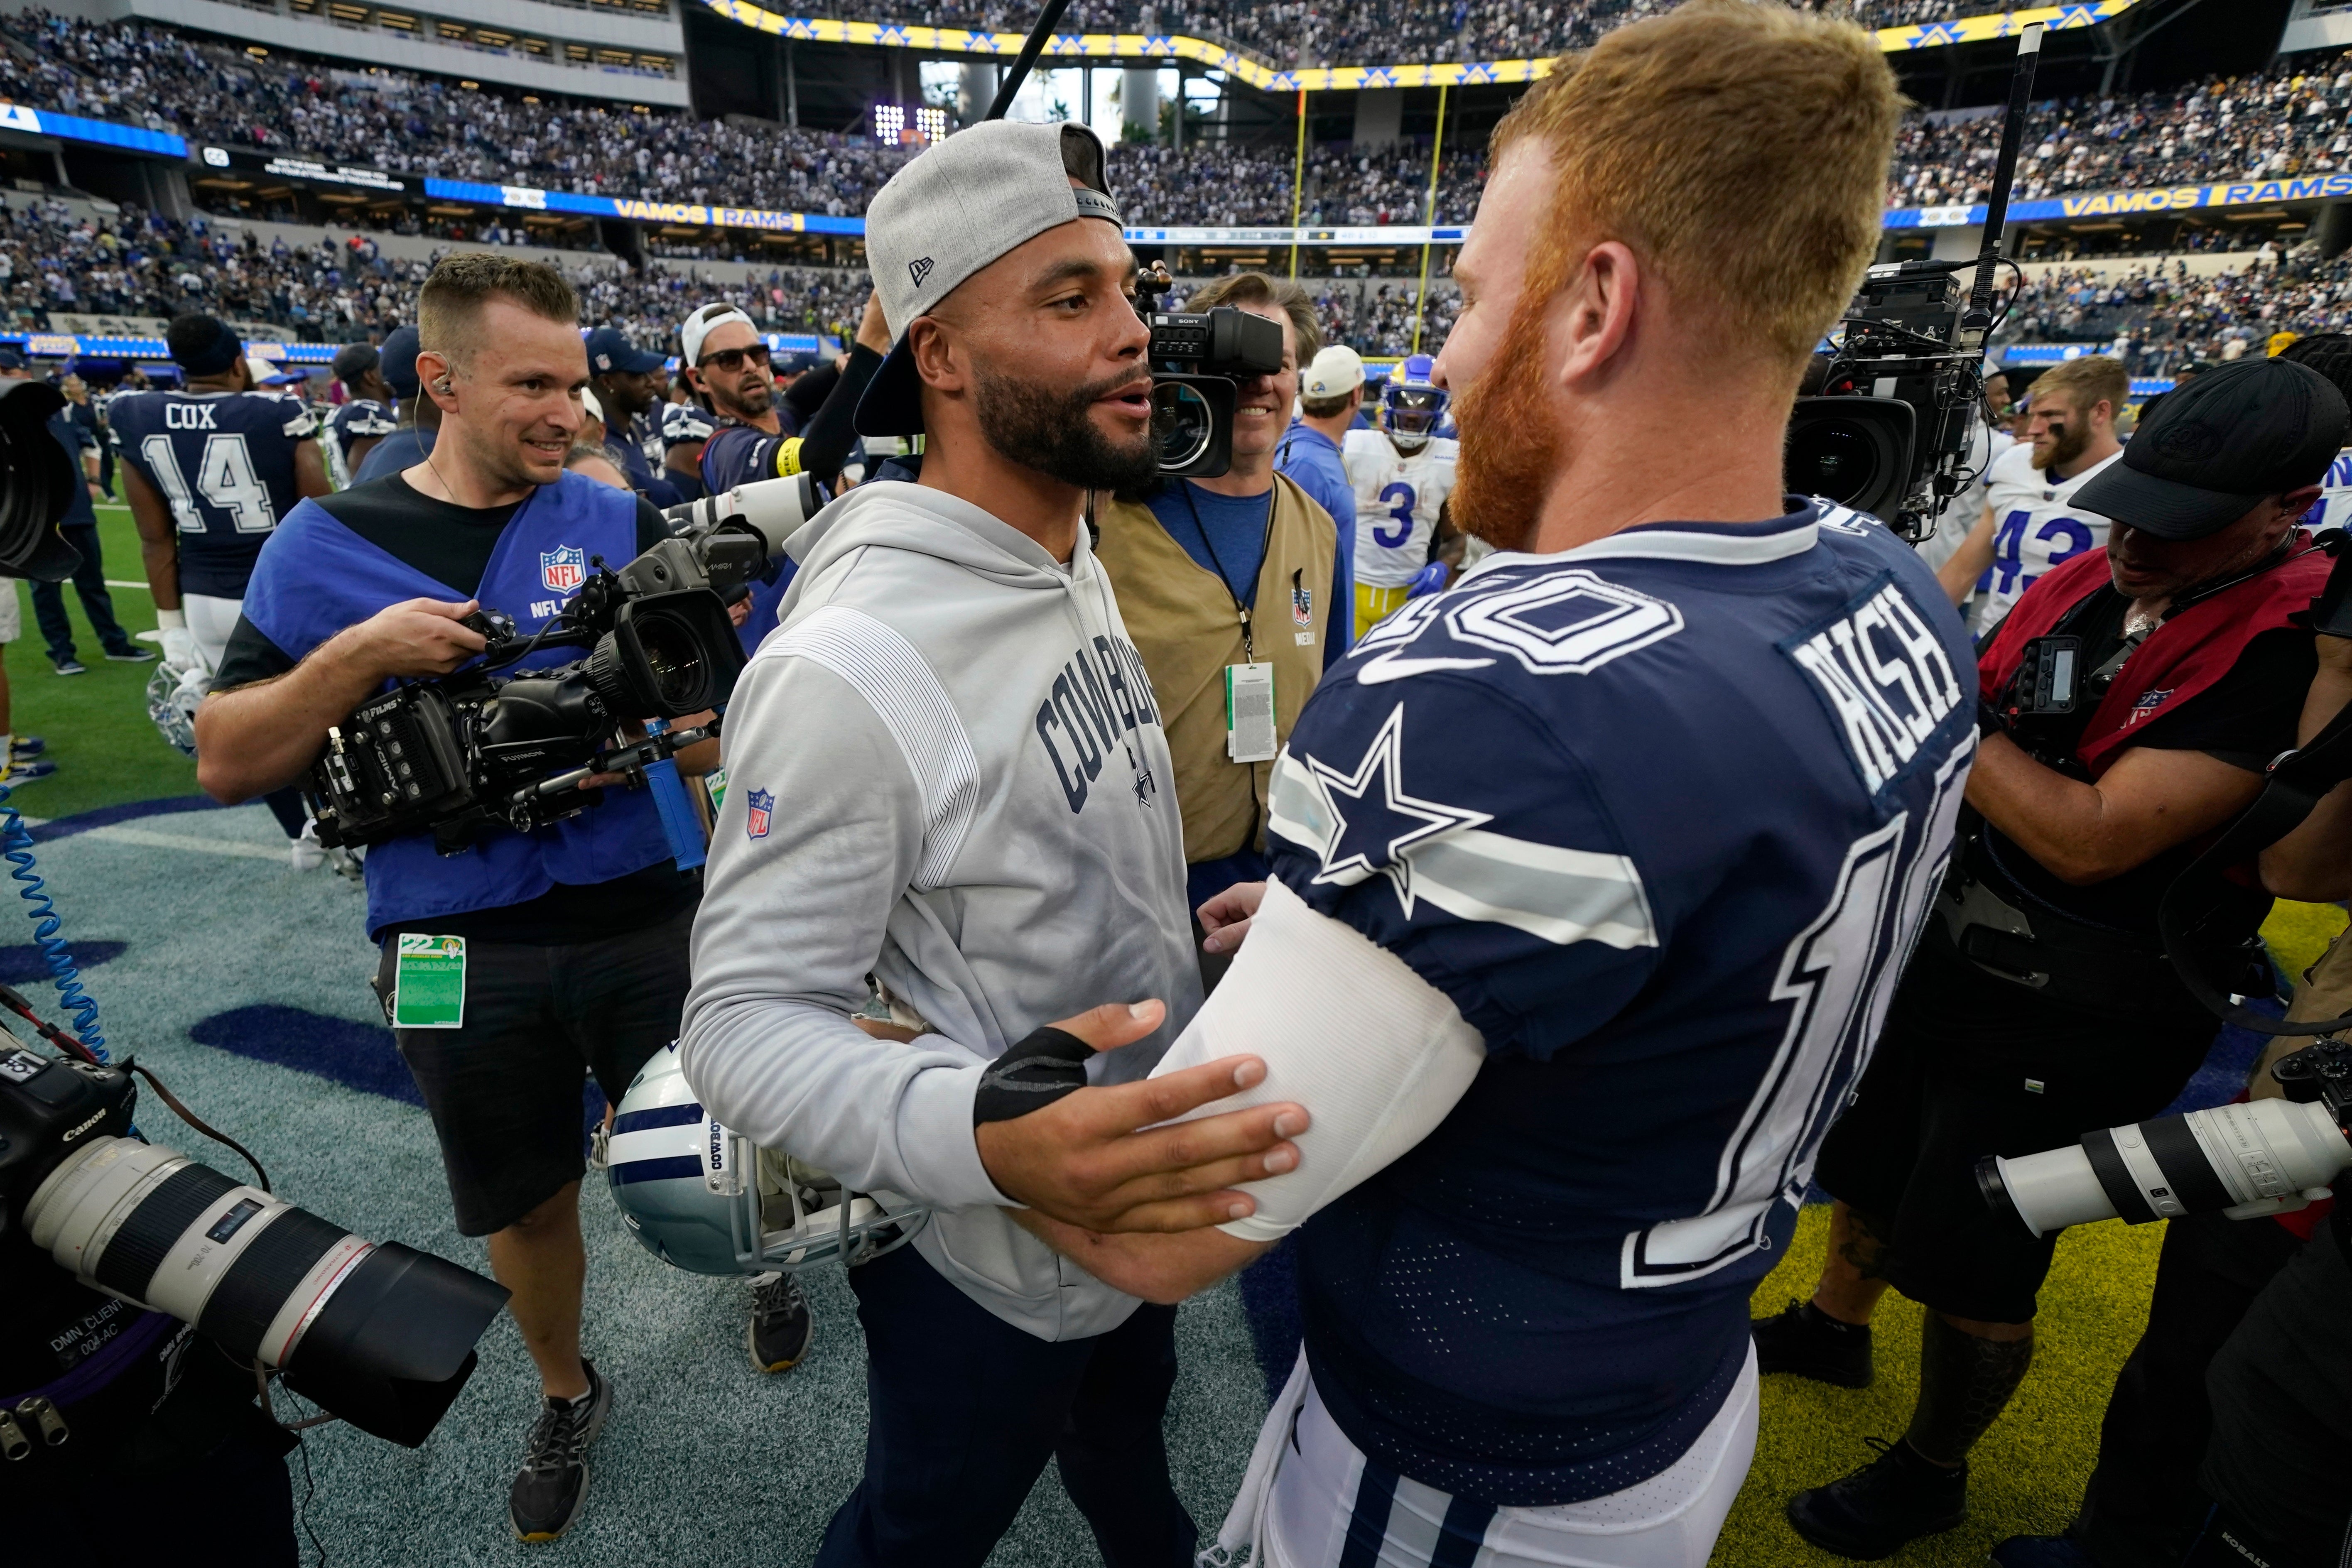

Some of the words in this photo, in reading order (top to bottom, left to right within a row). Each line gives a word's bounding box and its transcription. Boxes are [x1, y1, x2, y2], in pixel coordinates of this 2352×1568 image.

[2063, 187, 2200, 217] VAMOS
[2223, 175, 2352, 204] RAMS
[613, 198, 708, 225] VAMOS
[724, 209, 794, 230] RAMS
[166, 403, 217, 430] COX
[141, 433, 277, 534] 14
[1372, 481, 1416, 549] 3
[706, 562, 732, 571] AMIRA
[1994, 510, 2094, 594] 43
[547, 566, 581, 587] NFL
[530, 599, 561, 618] NFL
[1295, 632, 1316, 647] MEDIA
[370, 699, 397, 718] FILMS
[1035, 635, 1163, 815] COWBOY
[500, 750, 546, 762] FUJINON
[748, 808, 767, 836] NFL
[401, 935, 435, 951] 22
[2322, 1091, 2336, 1112] SONY
[62, 1107, 106, 1142] Canon
[711, 1117, 722, 1170] COWBO
[313, 1251, 344, 1285] ULTRASONIC
[50, 1298, 123, 1352] DMN_CLIENT
[2222, 1531, 2270, 1568] KOBALT
